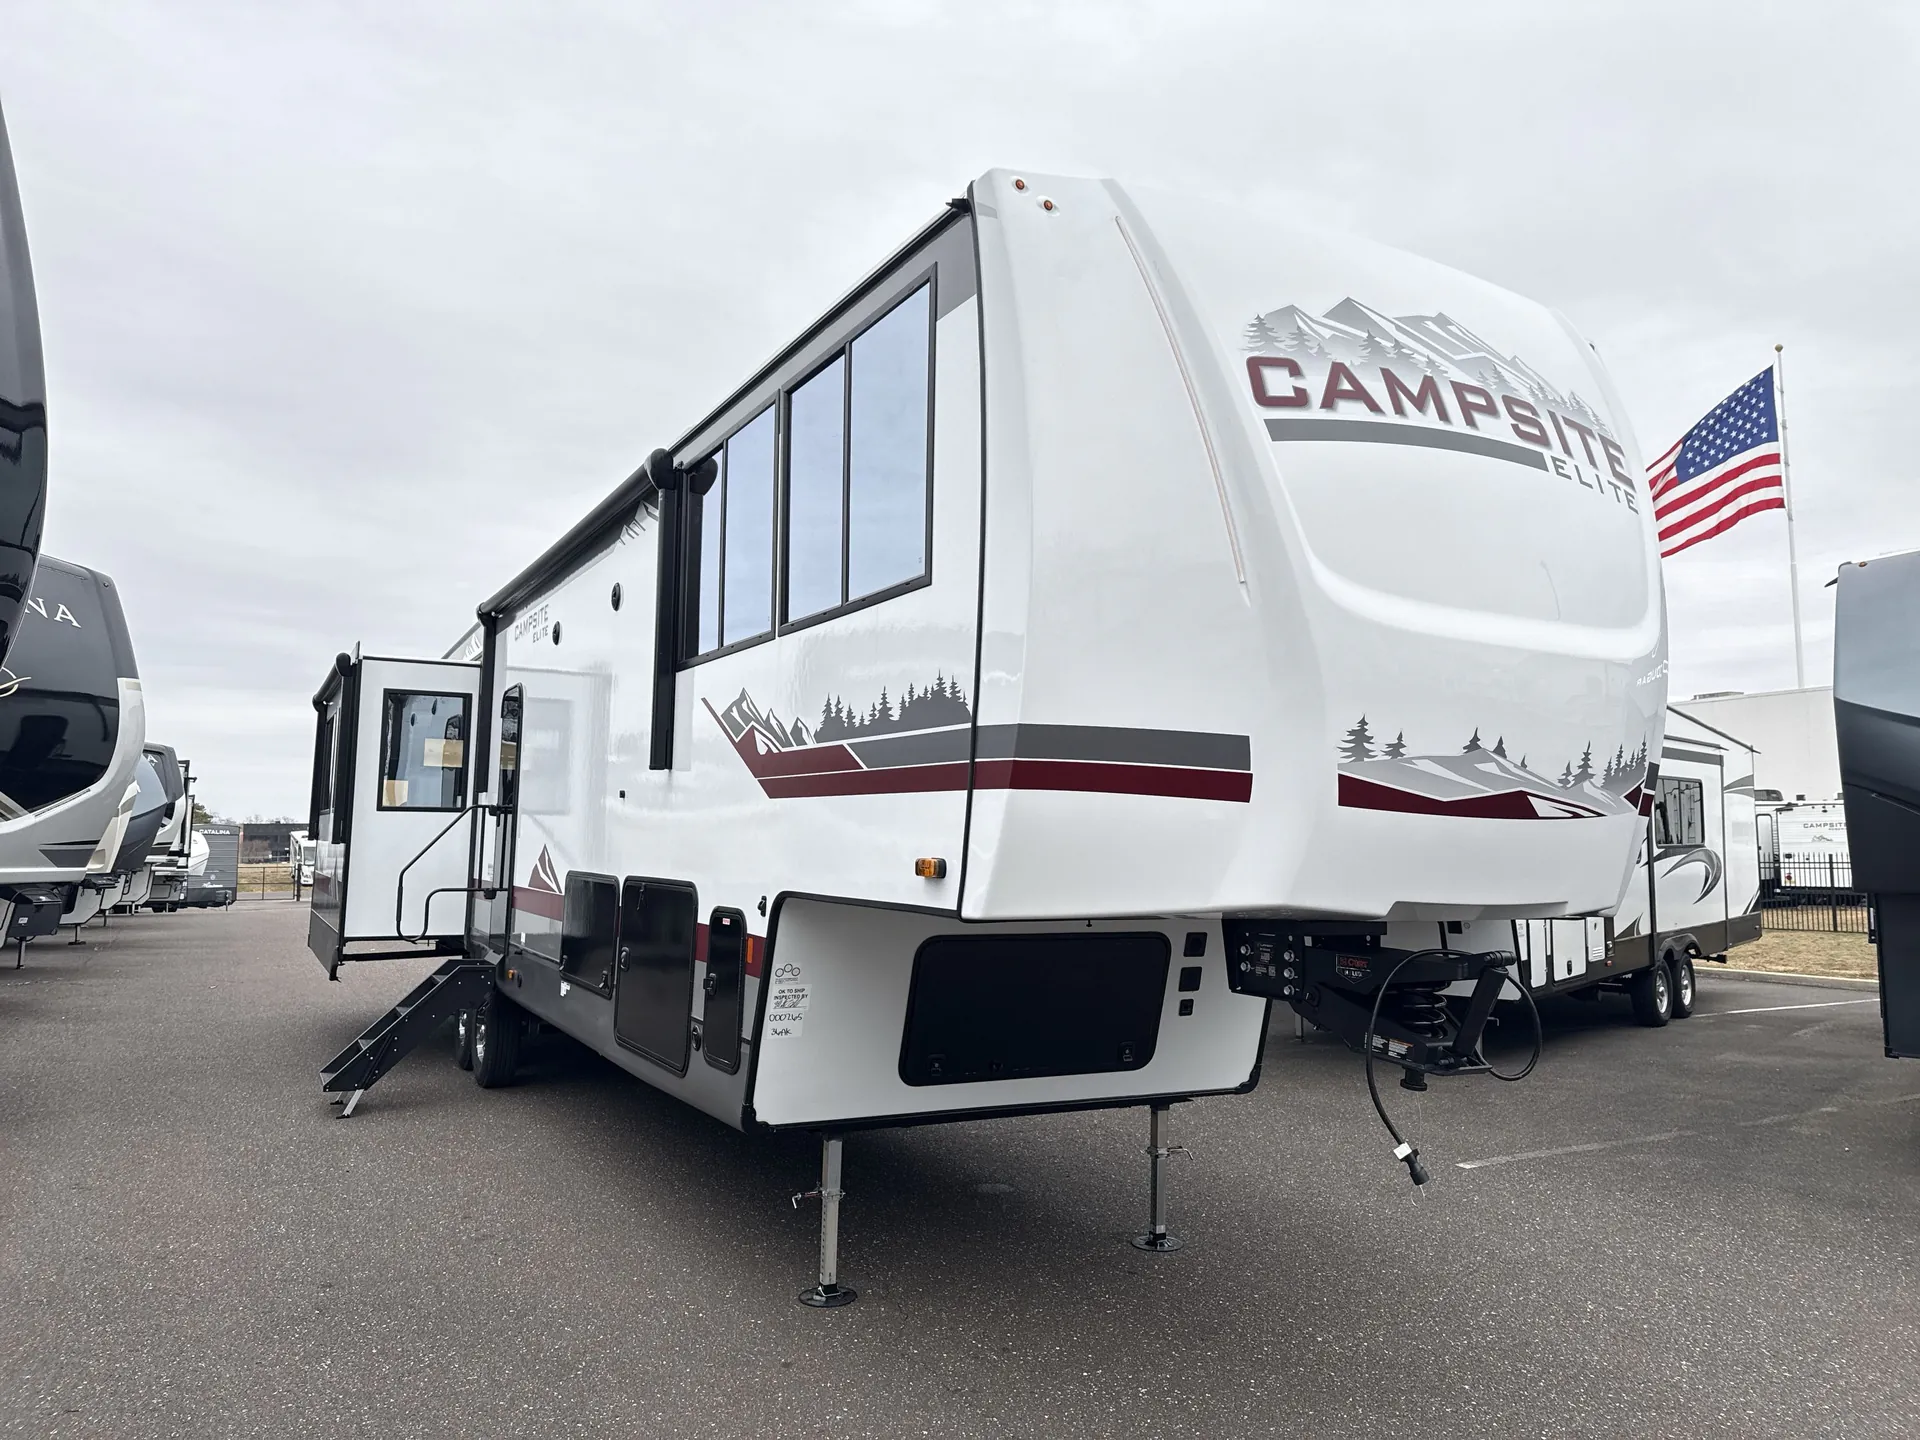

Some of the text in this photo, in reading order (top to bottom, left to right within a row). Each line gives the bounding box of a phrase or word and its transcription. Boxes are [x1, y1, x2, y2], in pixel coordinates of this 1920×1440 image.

[1246, 355, 1636, 491] CAMPSITE
[1551, 455, 1640, 516] ELITE
[515, 604, 548, 641] CAMPSITE
[533, 626, 548, 643] ELITE
